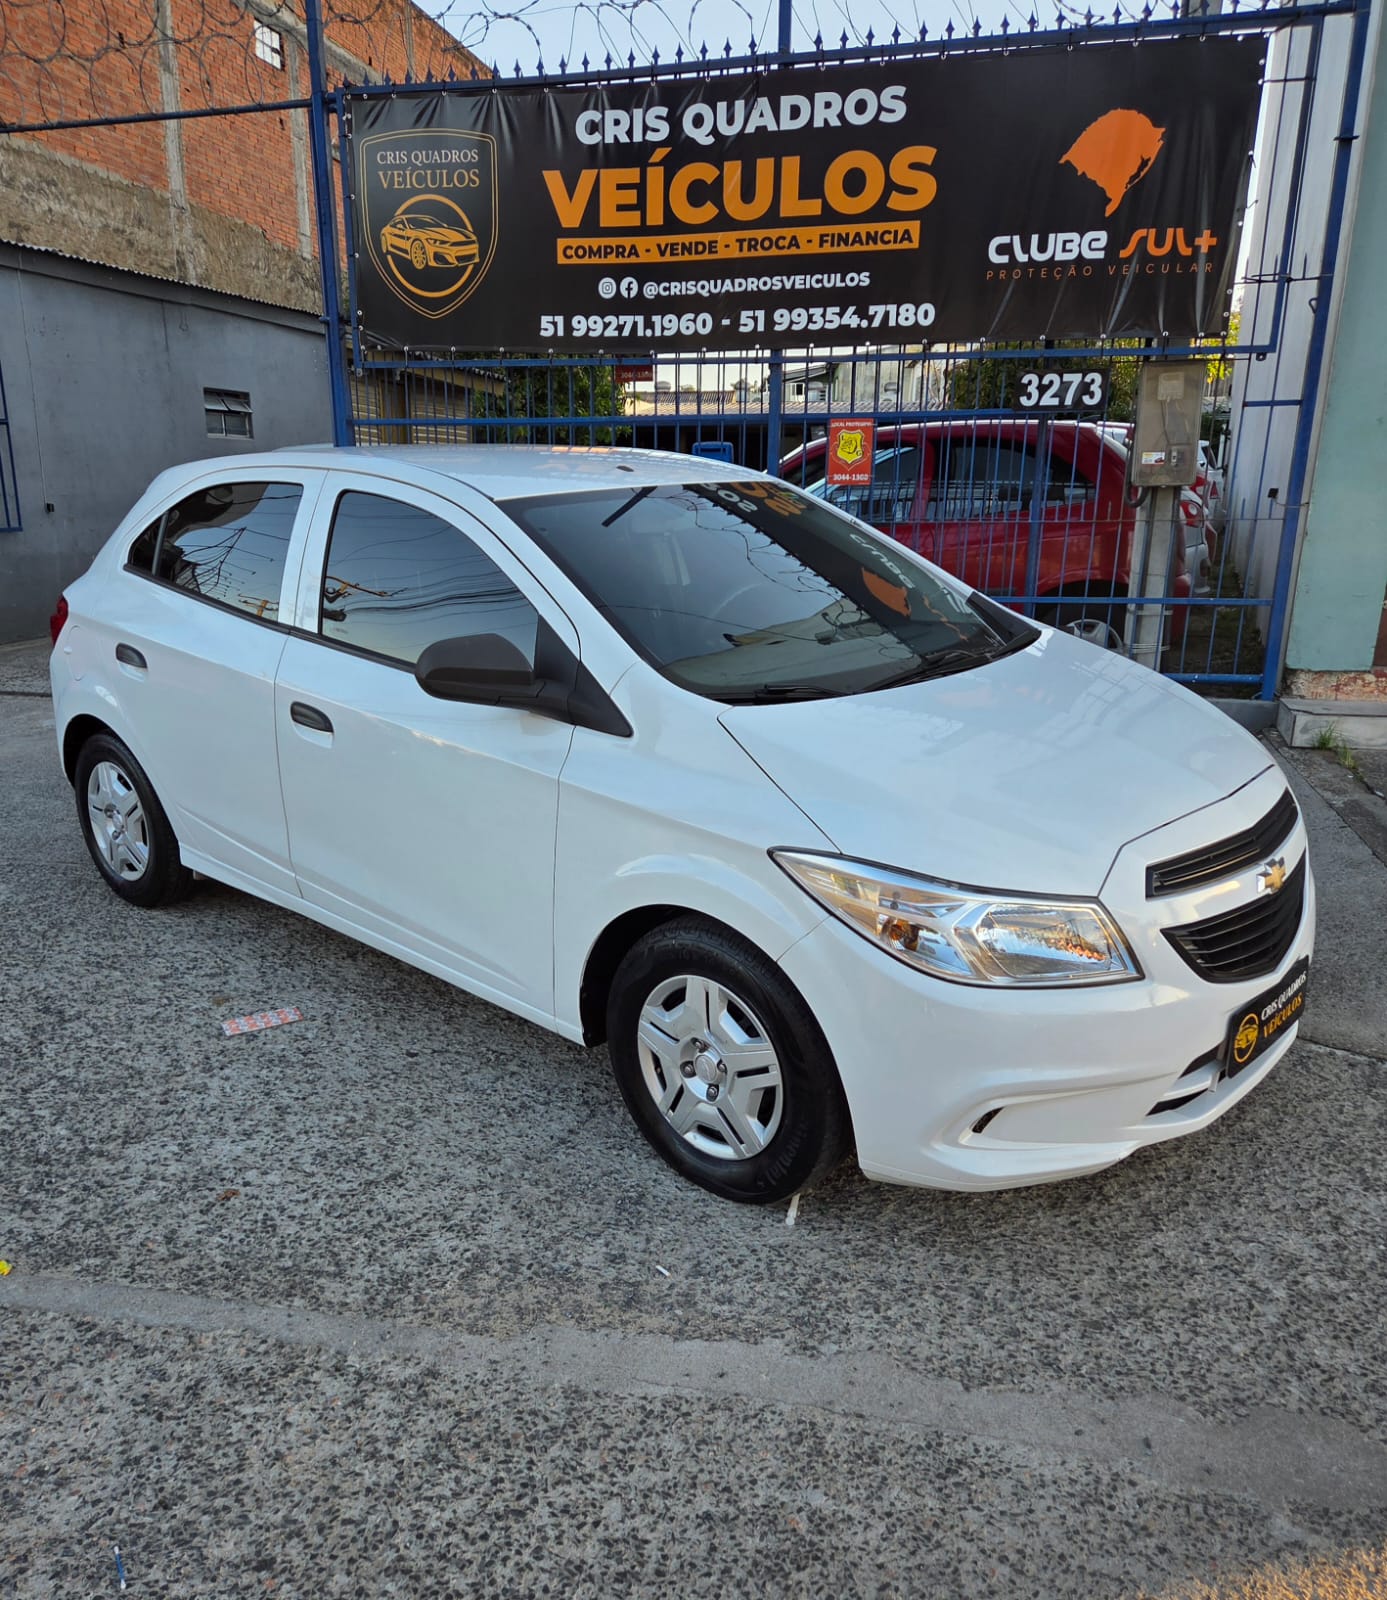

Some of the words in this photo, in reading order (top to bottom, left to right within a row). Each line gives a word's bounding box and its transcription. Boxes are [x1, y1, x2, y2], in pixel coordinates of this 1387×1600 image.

[575, 106, 670, 145] CRIS
[682, 85, 907, 146] QUADROS
[376, 150, 408, 165] CRIS
[411, 149, 479, 165] QUADROS
[377, 167, 480, 190] VEÍCULOS
[542, 145, 938, 229] VEÍCULOS
[562, 243, 641, 259] COMPRA
[656, 240, 719, 257] VENDE
[736, 235, 801, 252] TROCA
[818, 229, 914, 248] FINANCIA
[988, 230, 1108, 264] CLUBE
[642, 271, 871, 299] @CRISQUADROSVEICULOS
[986, 264, 1094, 281] PROTEÇÃO
[1107, 262, 1213, 276] VEICULAR
[539, 315, 564, 337] 51
[571, 312, 713, 338] 99271.1960
[738, 309, 766, 333] 51
[773, 302, 936, 332] 99354.7180
[1019, 372, 1103, 407] 3273
[1261, 1000, 1278, 1020] CRIS
[1278, 970, 1307, 1008] QUADROS
